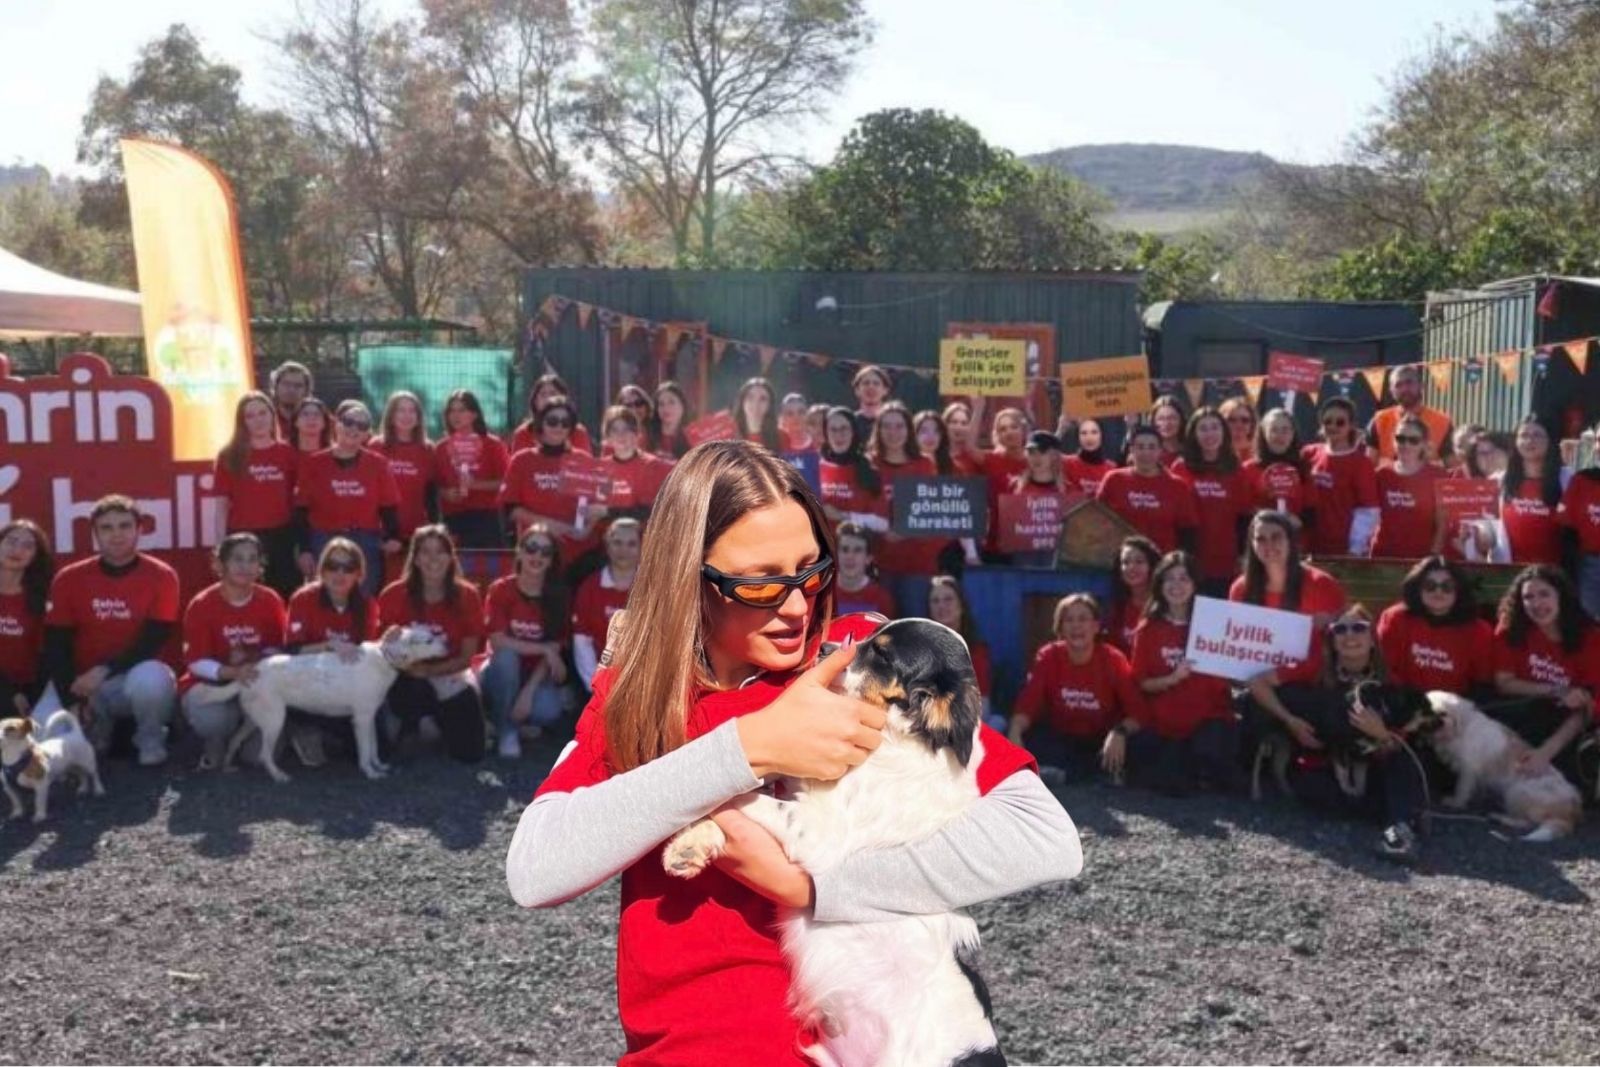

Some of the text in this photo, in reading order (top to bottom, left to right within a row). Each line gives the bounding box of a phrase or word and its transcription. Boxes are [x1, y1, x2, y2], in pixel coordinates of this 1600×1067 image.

[917, 484, 965, 497] Bu bir
[911, 500, 970, 514] gönüllü
[908, 515, 973, 529] hareketi
